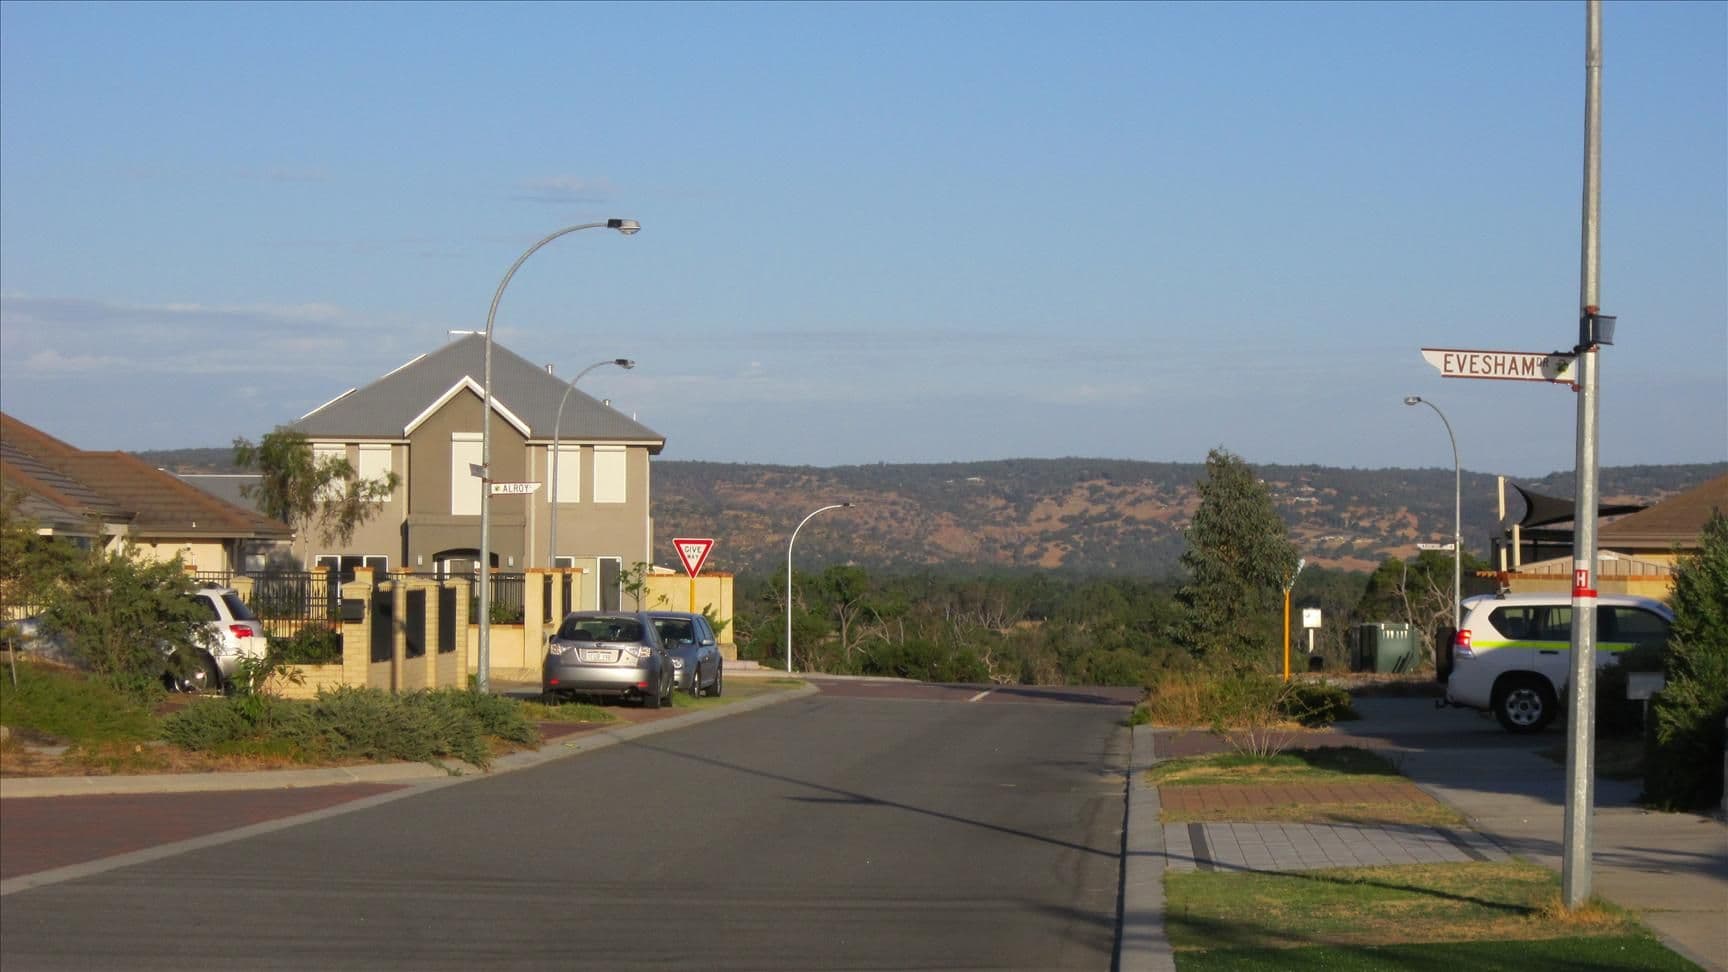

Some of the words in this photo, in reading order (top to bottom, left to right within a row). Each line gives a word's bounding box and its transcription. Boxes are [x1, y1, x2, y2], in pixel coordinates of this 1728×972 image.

[1443, 353, 1535, 376] EVESHAM
[1536, 357, 1549, 368] DR
[503, 484, 529, 493] ALROY
[684, 545, 702, 554] GIVE
[1576, 571, 1586, 587] H
